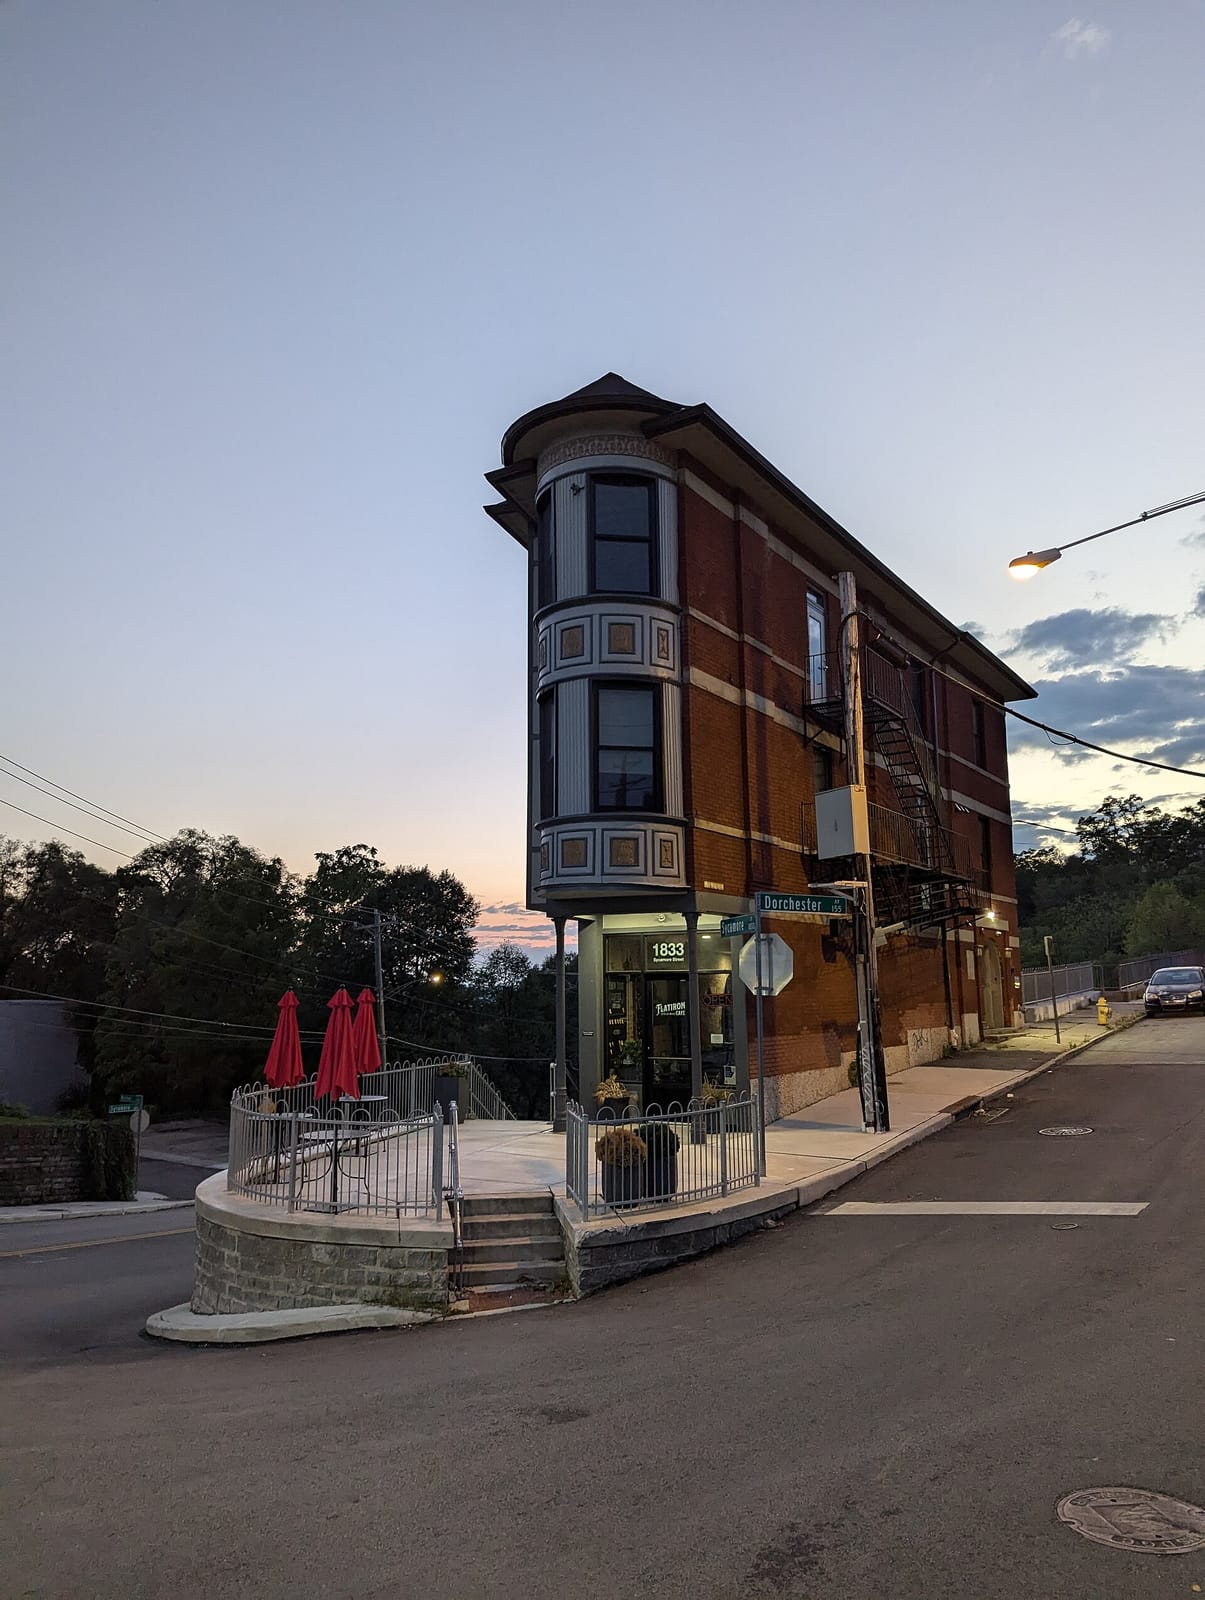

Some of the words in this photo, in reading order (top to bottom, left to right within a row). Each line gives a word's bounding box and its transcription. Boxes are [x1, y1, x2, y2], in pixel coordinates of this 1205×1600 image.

[764, 896, 822, 912] Dorchester
[652, 943, 685, 956] 1833
[704, 995, 732, 1005] OPEN
[655, 1001, 686, 1016] FLATIRON
